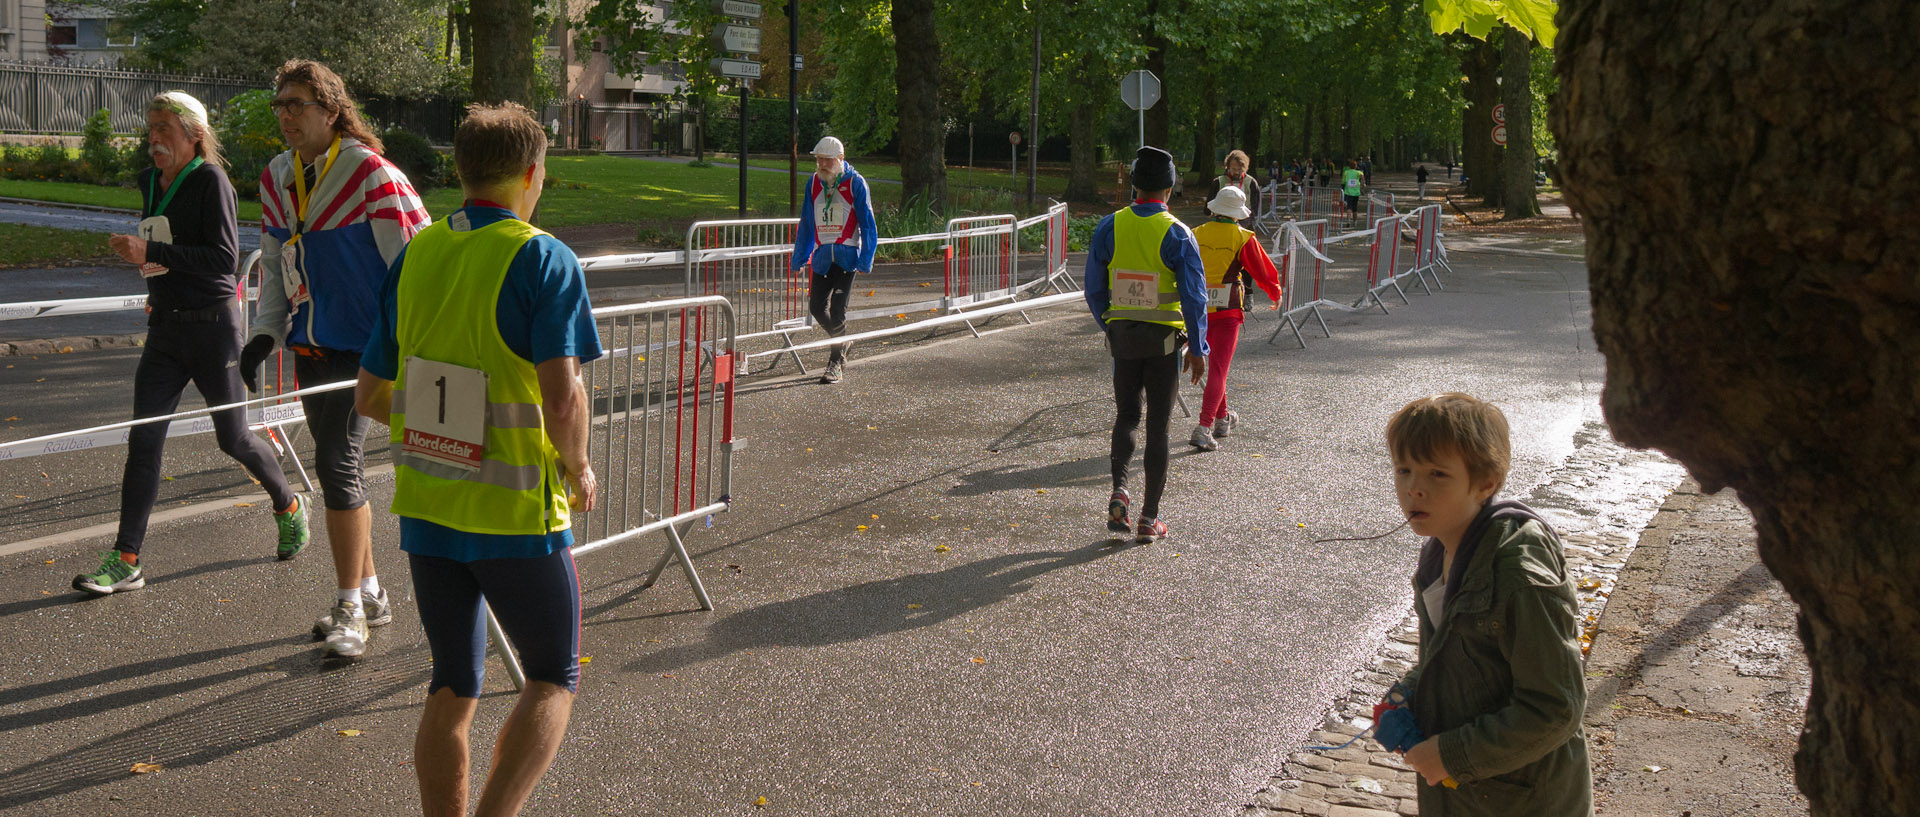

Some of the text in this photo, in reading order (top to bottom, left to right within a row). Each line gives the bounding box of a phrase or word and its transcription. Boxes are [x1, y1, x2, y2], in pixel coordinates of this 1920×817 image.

[1127, 281, 1145, 298] 42
[123, 298, 136, 307] Lille
[1118, 296, 1153, 305] CEPS
[435, 375, 446, 425] 1
[258, 405, 295, 423] Roubaix
[43, 435, 95, 454] Roubaix
